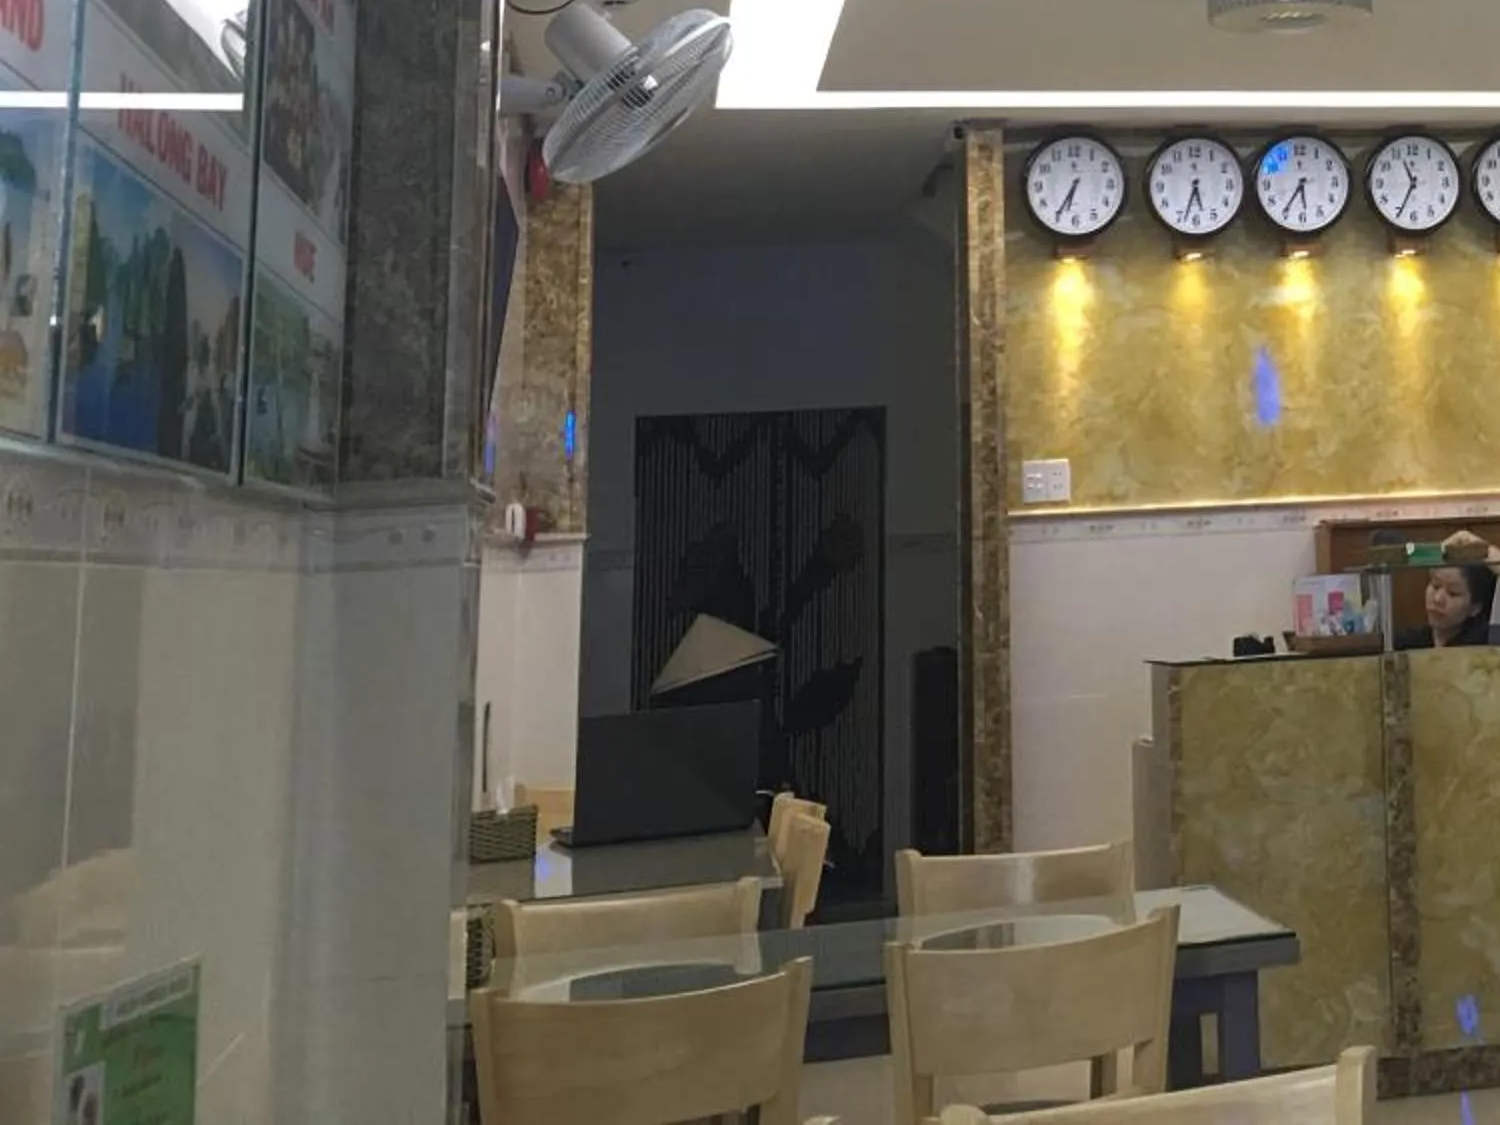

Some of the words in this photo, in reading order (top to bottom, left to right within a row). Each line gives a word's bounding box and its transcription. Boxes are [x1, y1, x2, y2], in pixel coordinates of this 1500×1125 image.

[1067, 145, 1081, 158] 12
[1189, 145, 1200, 158] 12
[1293, 144, 1306, 156] 12
[1407, 144, 1419, 156] 12
